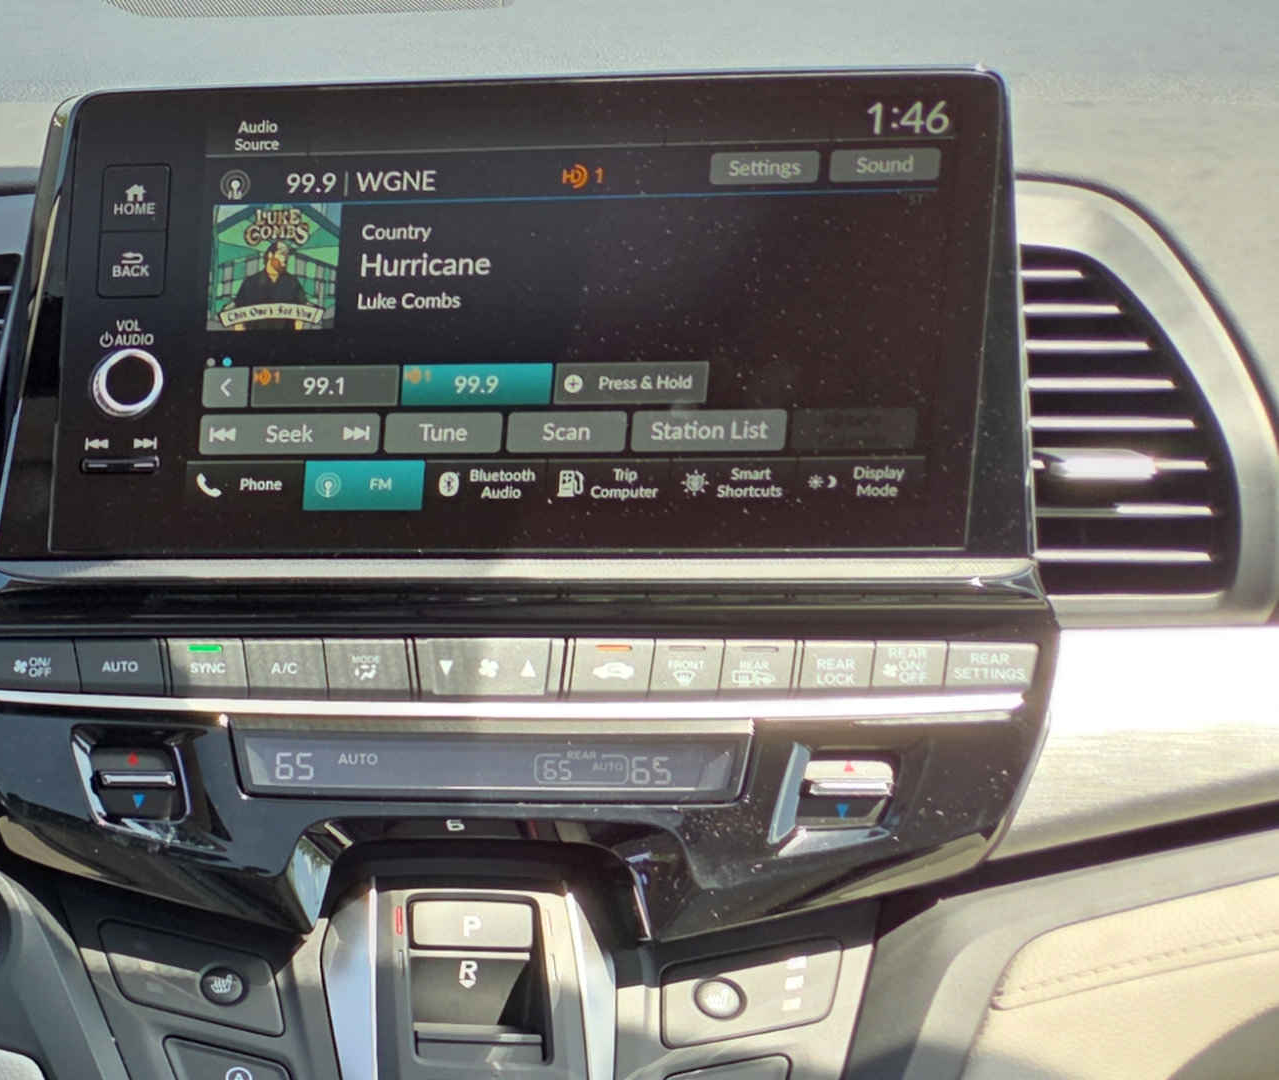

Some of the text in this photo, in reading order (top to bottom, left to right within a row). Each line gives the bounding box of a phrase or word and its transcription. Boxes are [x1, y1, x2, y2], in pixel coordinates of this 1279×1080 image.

[867, 101, 950, 134] 1:46
[238, 119, 278, 134] Audio
[235, 138, 280, 151] Source
[729, 159, 801, 179] Settings
[856, 156, 914, 174] Sound
[286, 170, 437, 194] 99.9 WGNE
[594, 167, 605, 184] 1
[113, 203, 156, 216] HOME
[361, 223, 432, 243] Country
[112, 264, 150, 278] BACK
[360, 254, 491, 277] Hurricane
[357, 293, 461, 310] Luke Combs
[116, 320, 141, 332] VOL
[114, 334, 154, 346] AUDIO
[303, 376, 345, 395] 99.1
[454, 376, 499, 394] 99.9
[598, 375, 692, 390] Press & Hold
[266, 424, 313, 443] Seek
[419, 425, 467, 442] Tune
[542, 424, 590, 441] Scan
[651, 422, 768, 441] Station List
[469, 468, 536, 484] Bluetooth
[613, 468, 638, 484] Trip
[731, 467, 771, 481] Smart
[853, 466, 904, 483] Display
[240, 477, 283, 492] Phone
[369, 478, 392, 491] FM
[717, 484, 782, 499] Shortcuts
[856, 483, 898, 497] Mode
[481, 485, 521, 500] Audio
[590, 485, 659, 501] Computer
[352, 655, 381, 664] MODE
[888, 647, 927, 659] REAR
[970, 652, 1010, 665] REAR
[29, 656, 52, 667] ON/
[102, 661, 138, 673] AUTO
[190, 662, 226, 675] SYNC
[271, 662, 298, 675] A/C
[668, 660, 705, 670] FRONT
[740, 660, 769, 670] REAR
[817, 658, 855, 670] REAR
[29, 667, 52, 678] OFF
[817, 672, 855, 685] LOCK
[899, 672, 928, 683] OFF
[953, 667, 1026, 682] SETTINGS
[338, 753, 378, 765] AUTO
[567, 750, 596, 761] REAR
[275, 752, 314, 780] 65
[543, 760, 624, 781] 65 AUTO
[631, 757, 672, 785] 65
[463, 915, 481, 937] P
[459, 960, 478, 981] R
